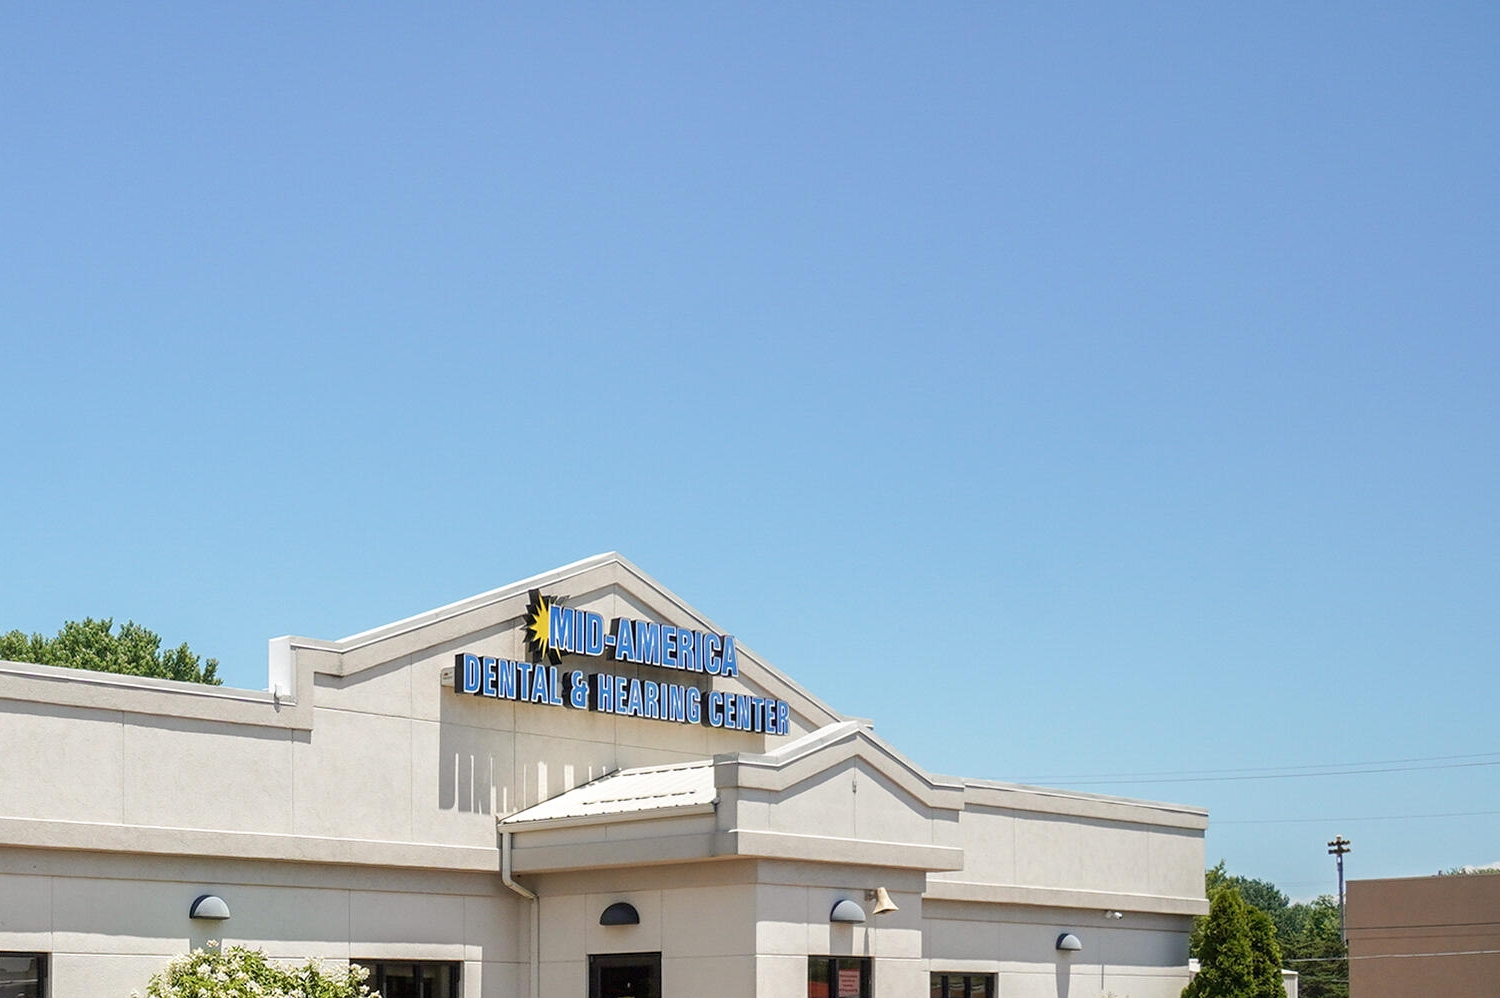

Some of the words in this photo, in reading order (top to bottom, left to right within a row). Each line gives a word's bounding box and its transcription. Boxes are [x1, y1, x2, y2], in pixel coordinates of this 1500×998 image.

[549, 603, 739, 678] MID-AMERICA
[462, 653, 563, 706] DENTAL
[570, 670, 590, 709] &
[597, 673, 701, 725] HEARING
[707, 691, 790, 736] CENTER
